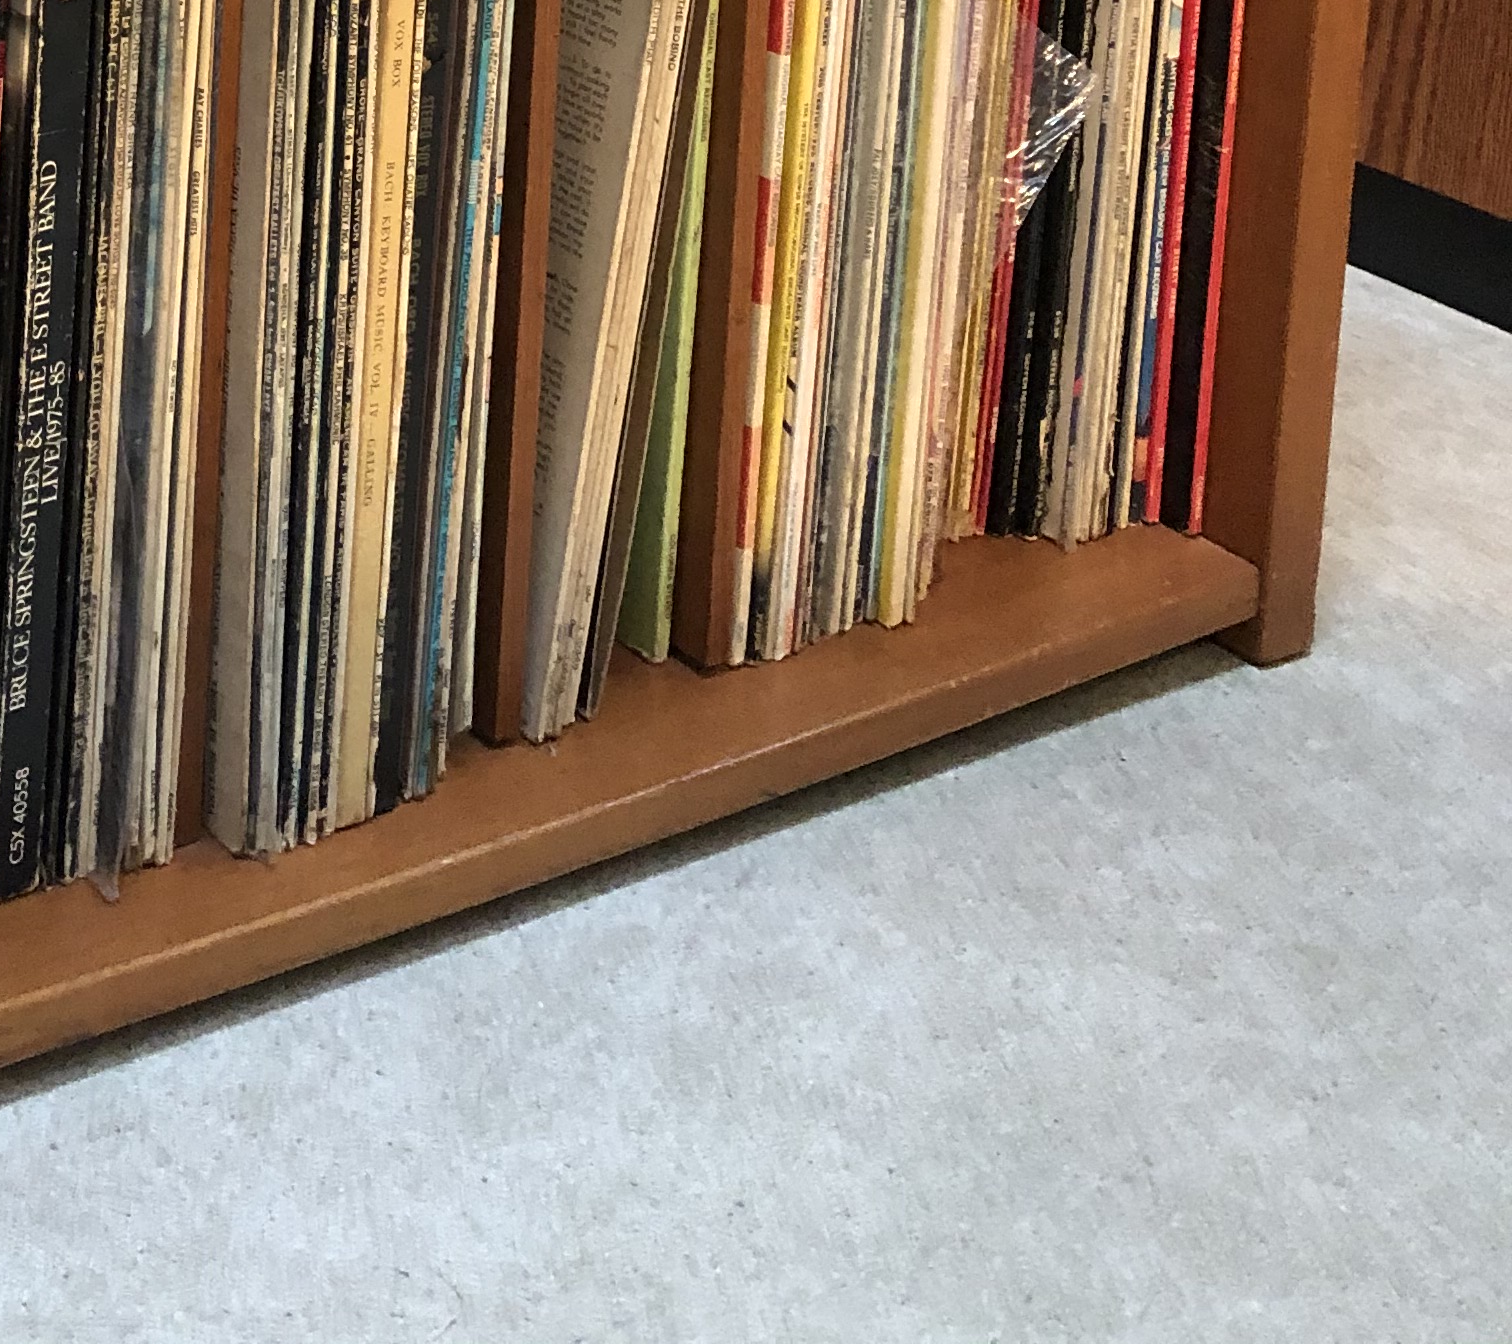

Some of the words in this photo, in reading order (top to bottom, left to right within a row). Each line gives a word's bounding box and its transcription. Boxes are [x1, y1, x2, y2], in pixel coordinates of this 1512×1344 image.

[676, 0, 687, 22] THE
[394, 20, 406, 51] VOX
[667, 25, 682, 72] BOBINO
[392, 59, 404, 88] BOX
[196, 87, 205, 106] RAY
[195, 110, 204, 148] CHARLES
[38, 160, 57, 232] BAND
[190, 170, 201, 214] GREATEST
[190, 218, 198, 236] HITS
[376, 216, 392, 298] KEYBOARD
[31, 243, 54, 340] STREET
[31, 344, 48, 362] E
[26, 365, 46, 425] THE
[369, 403, 380, 418] IV
[26, 430, 43, 449] &
[362, 439, 376, 507] GALLING
[14, 458, 41, 626] SPRINGSTEEN
[9, 630, 32, 712] BRUCE
[11, 766, 30, 822] 40558
[8, 830, 26, 864] C5X
